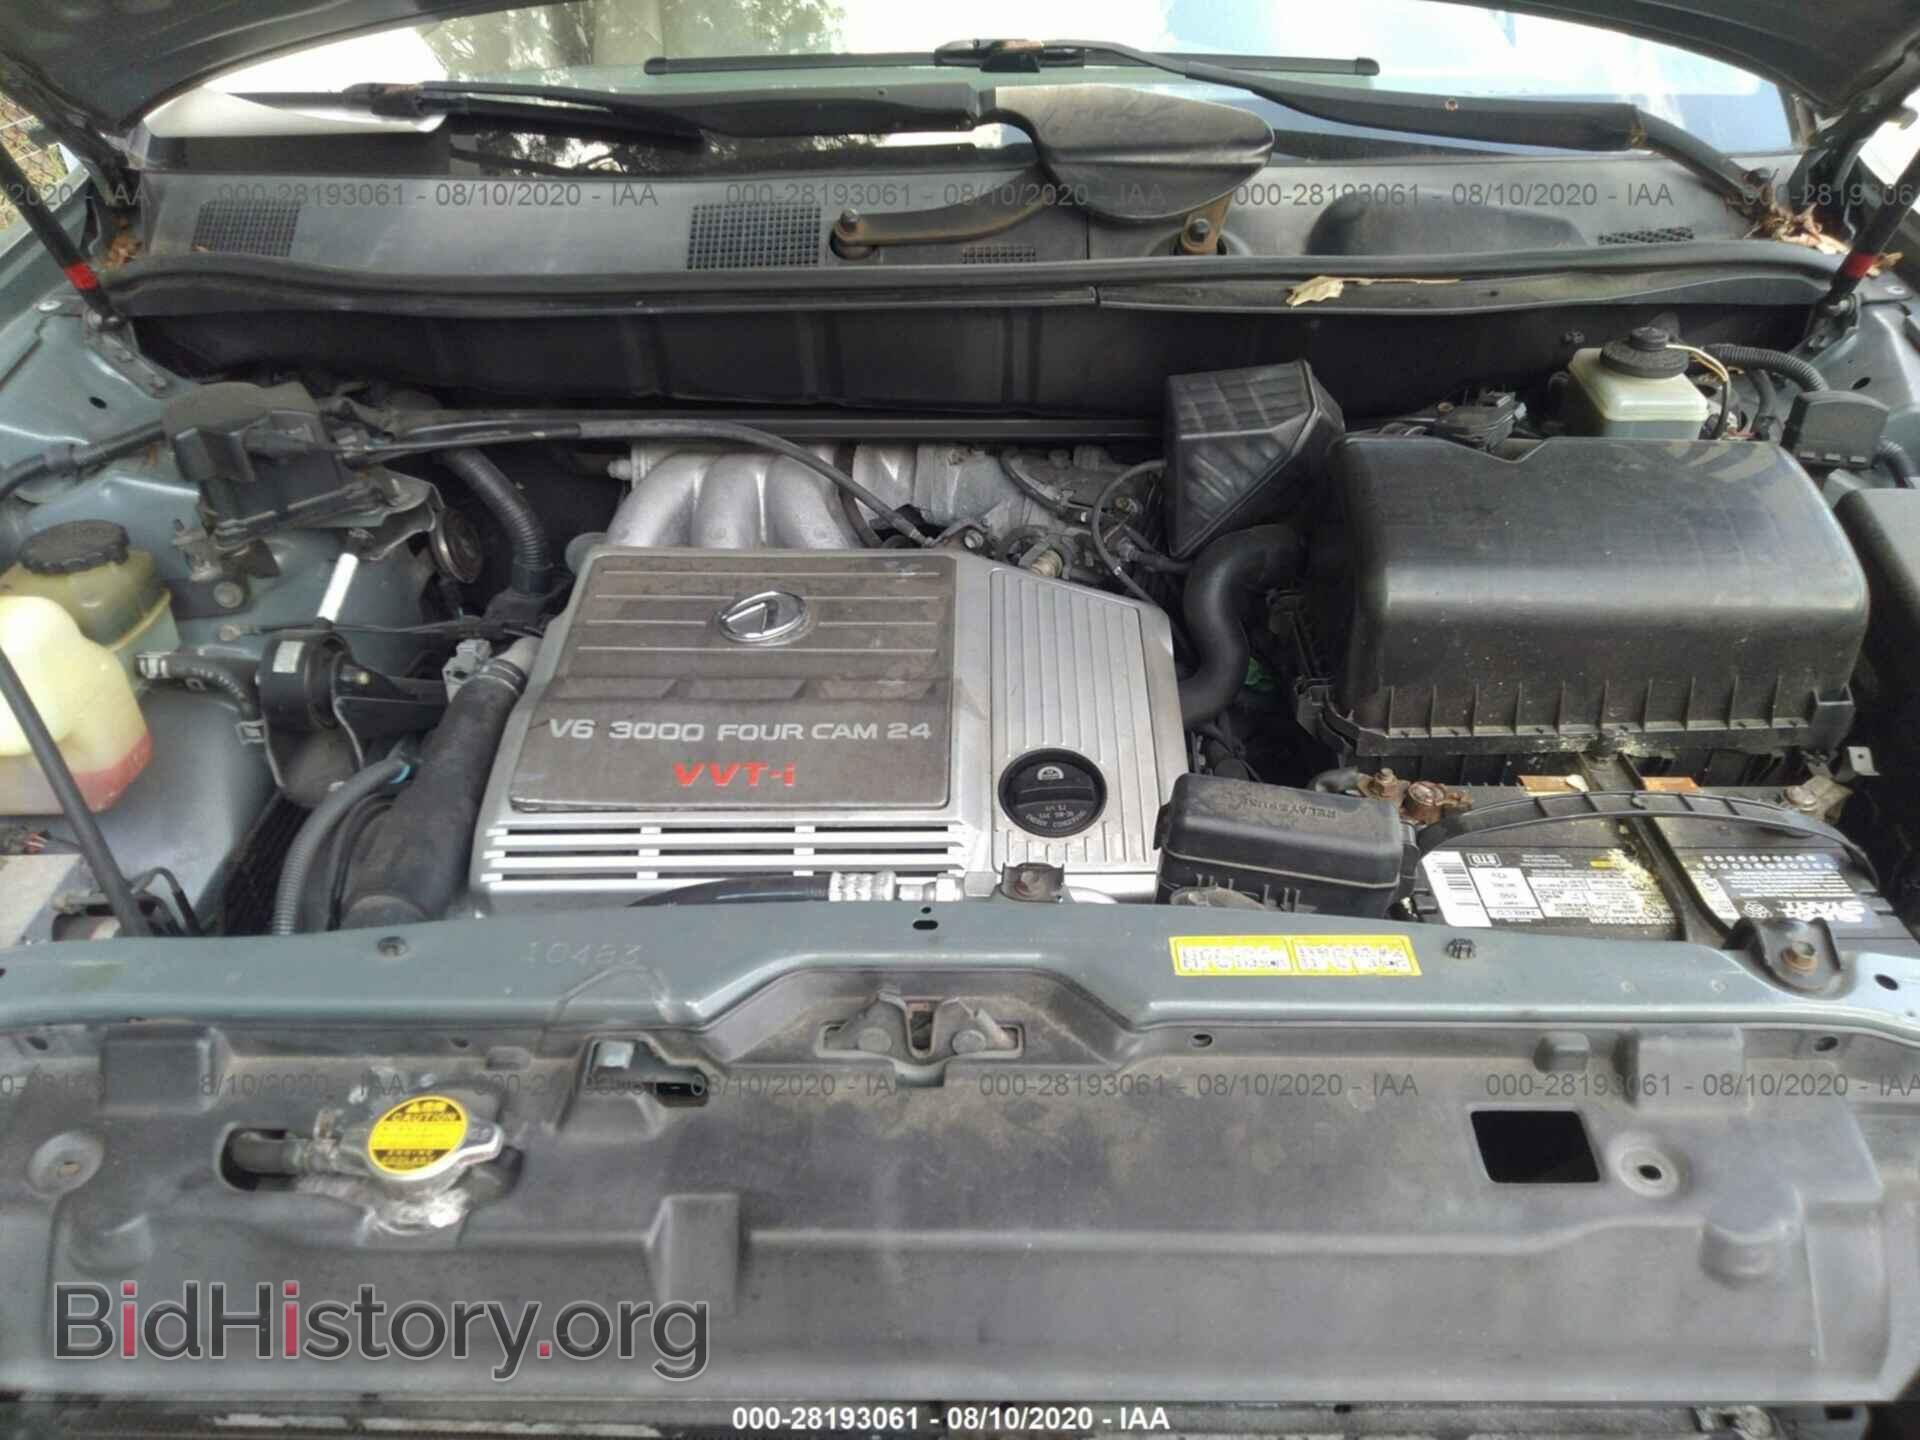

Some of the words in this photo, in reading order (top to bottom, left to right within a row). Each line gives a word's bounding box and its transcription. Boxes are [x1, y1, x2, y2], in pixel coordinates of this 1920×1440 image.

[549, 718, 596, 739] V6
[608, 720, 704, 742] 3000
[717, 723, 804, 742] FOUR
[811, 722, 879, 741] CAM
[887, 722, 932, 740] 24
[673, 761, 796, 787] VVT-i
